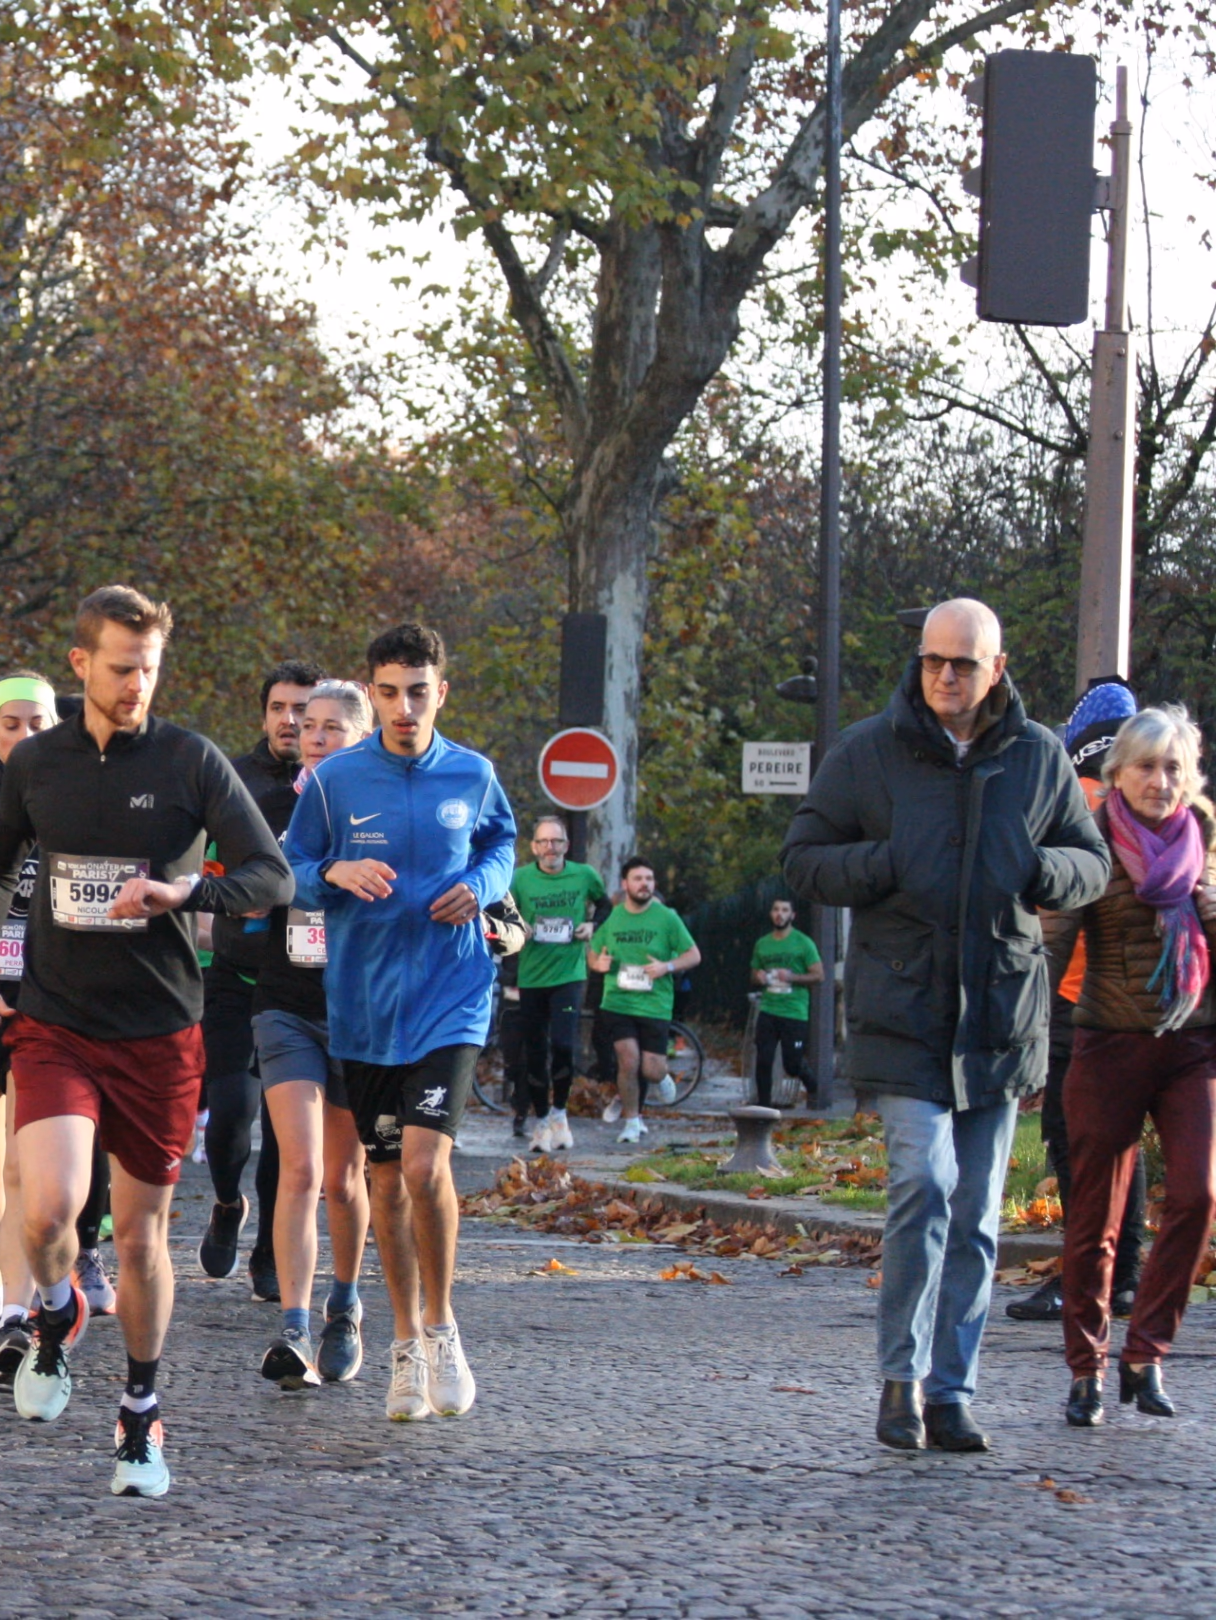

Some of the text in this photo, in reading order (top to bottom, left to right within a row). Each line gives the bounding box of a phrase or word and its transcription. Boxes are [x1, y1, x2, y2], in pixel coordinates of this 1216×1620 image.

[749, 761, 803, 774] PEREIRE
[2, 929, 24, 939] PARI
[307, 927, 326, 945] 39
